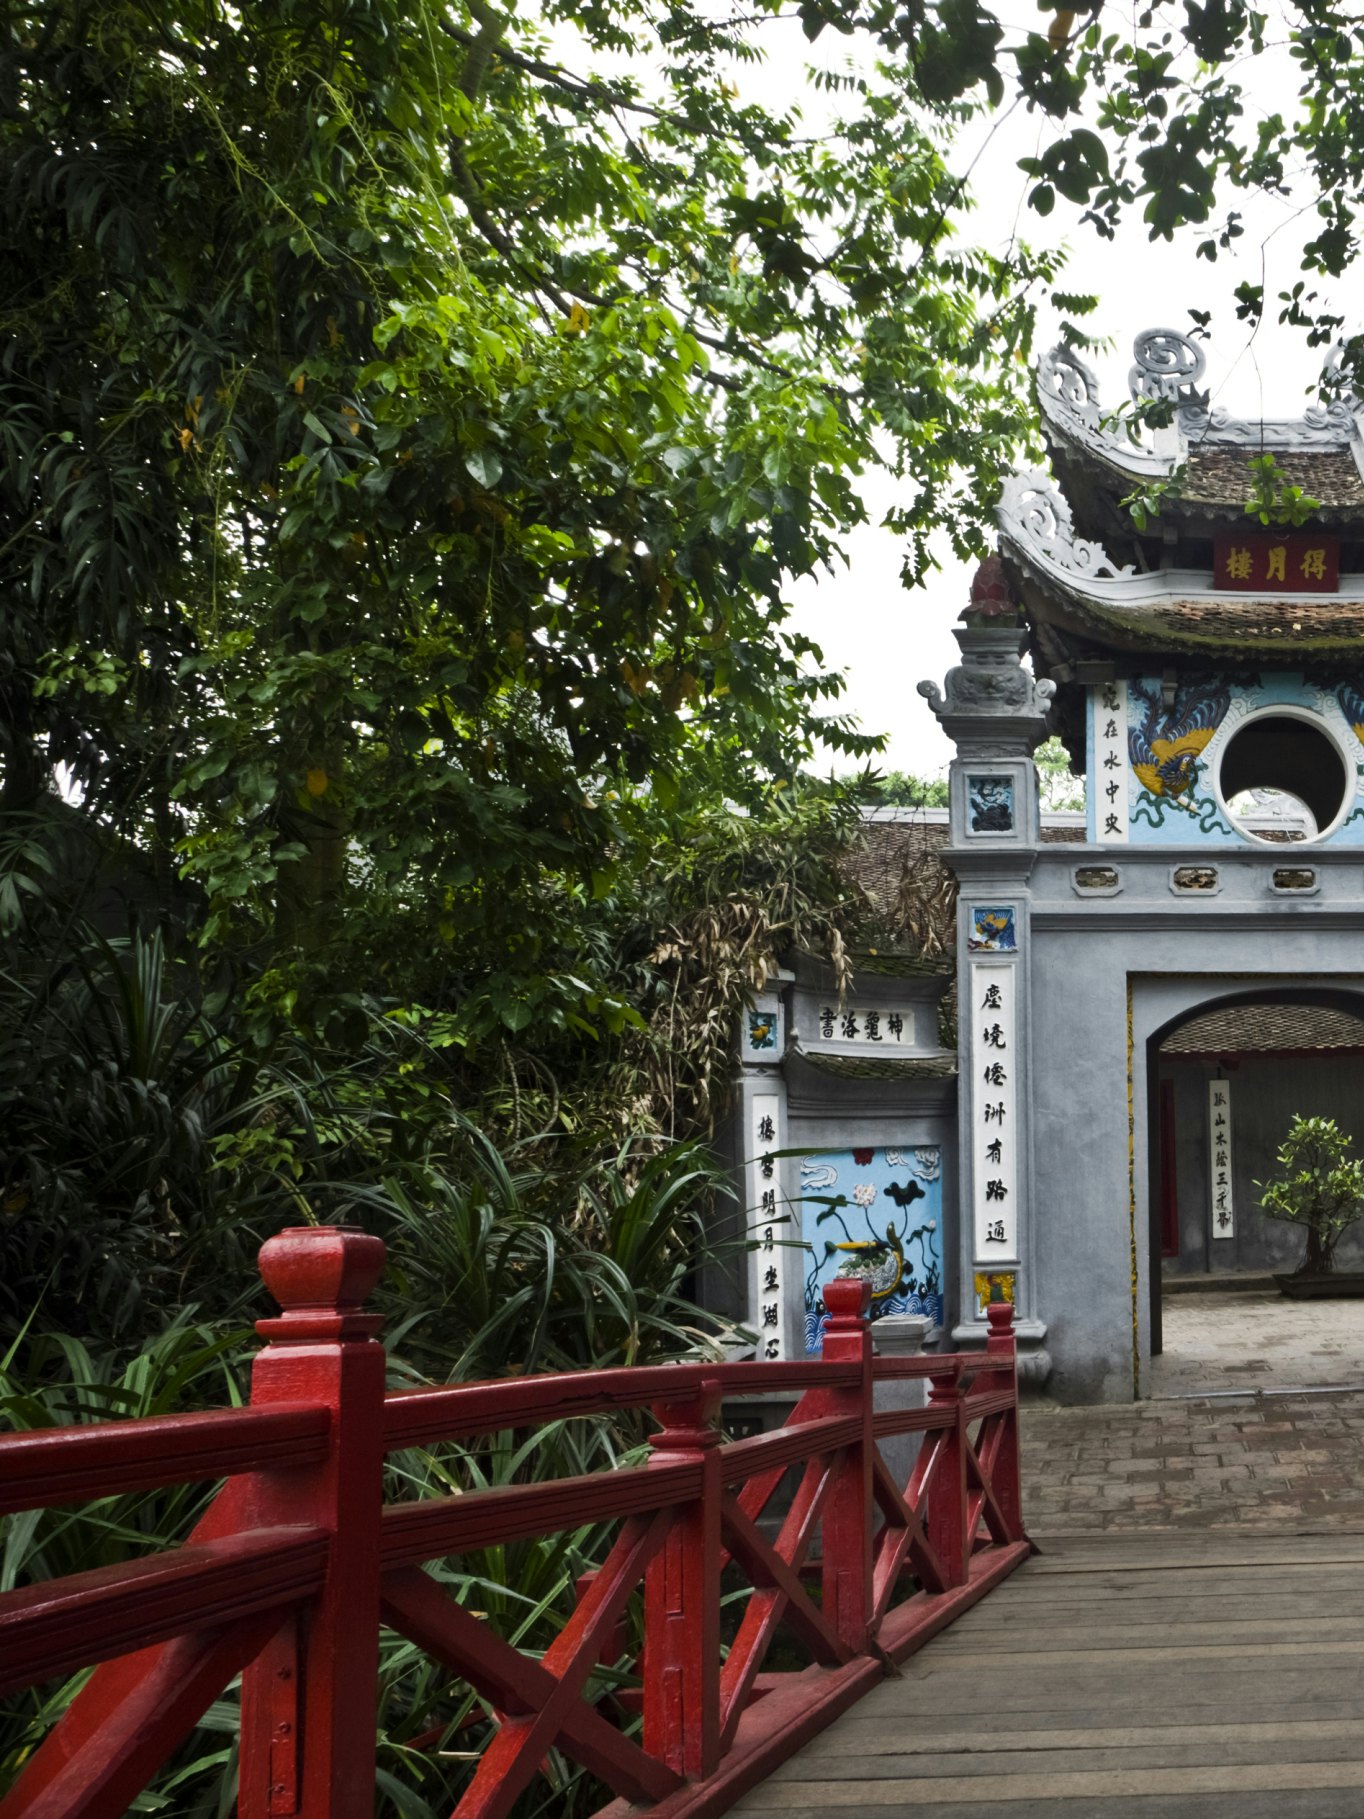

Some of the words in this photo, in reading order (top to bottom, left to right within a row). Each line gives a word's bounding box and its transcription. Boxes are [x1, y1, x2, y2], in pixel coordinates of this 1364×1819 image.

[1102, 686, 1123, 835] 宛在水中央
